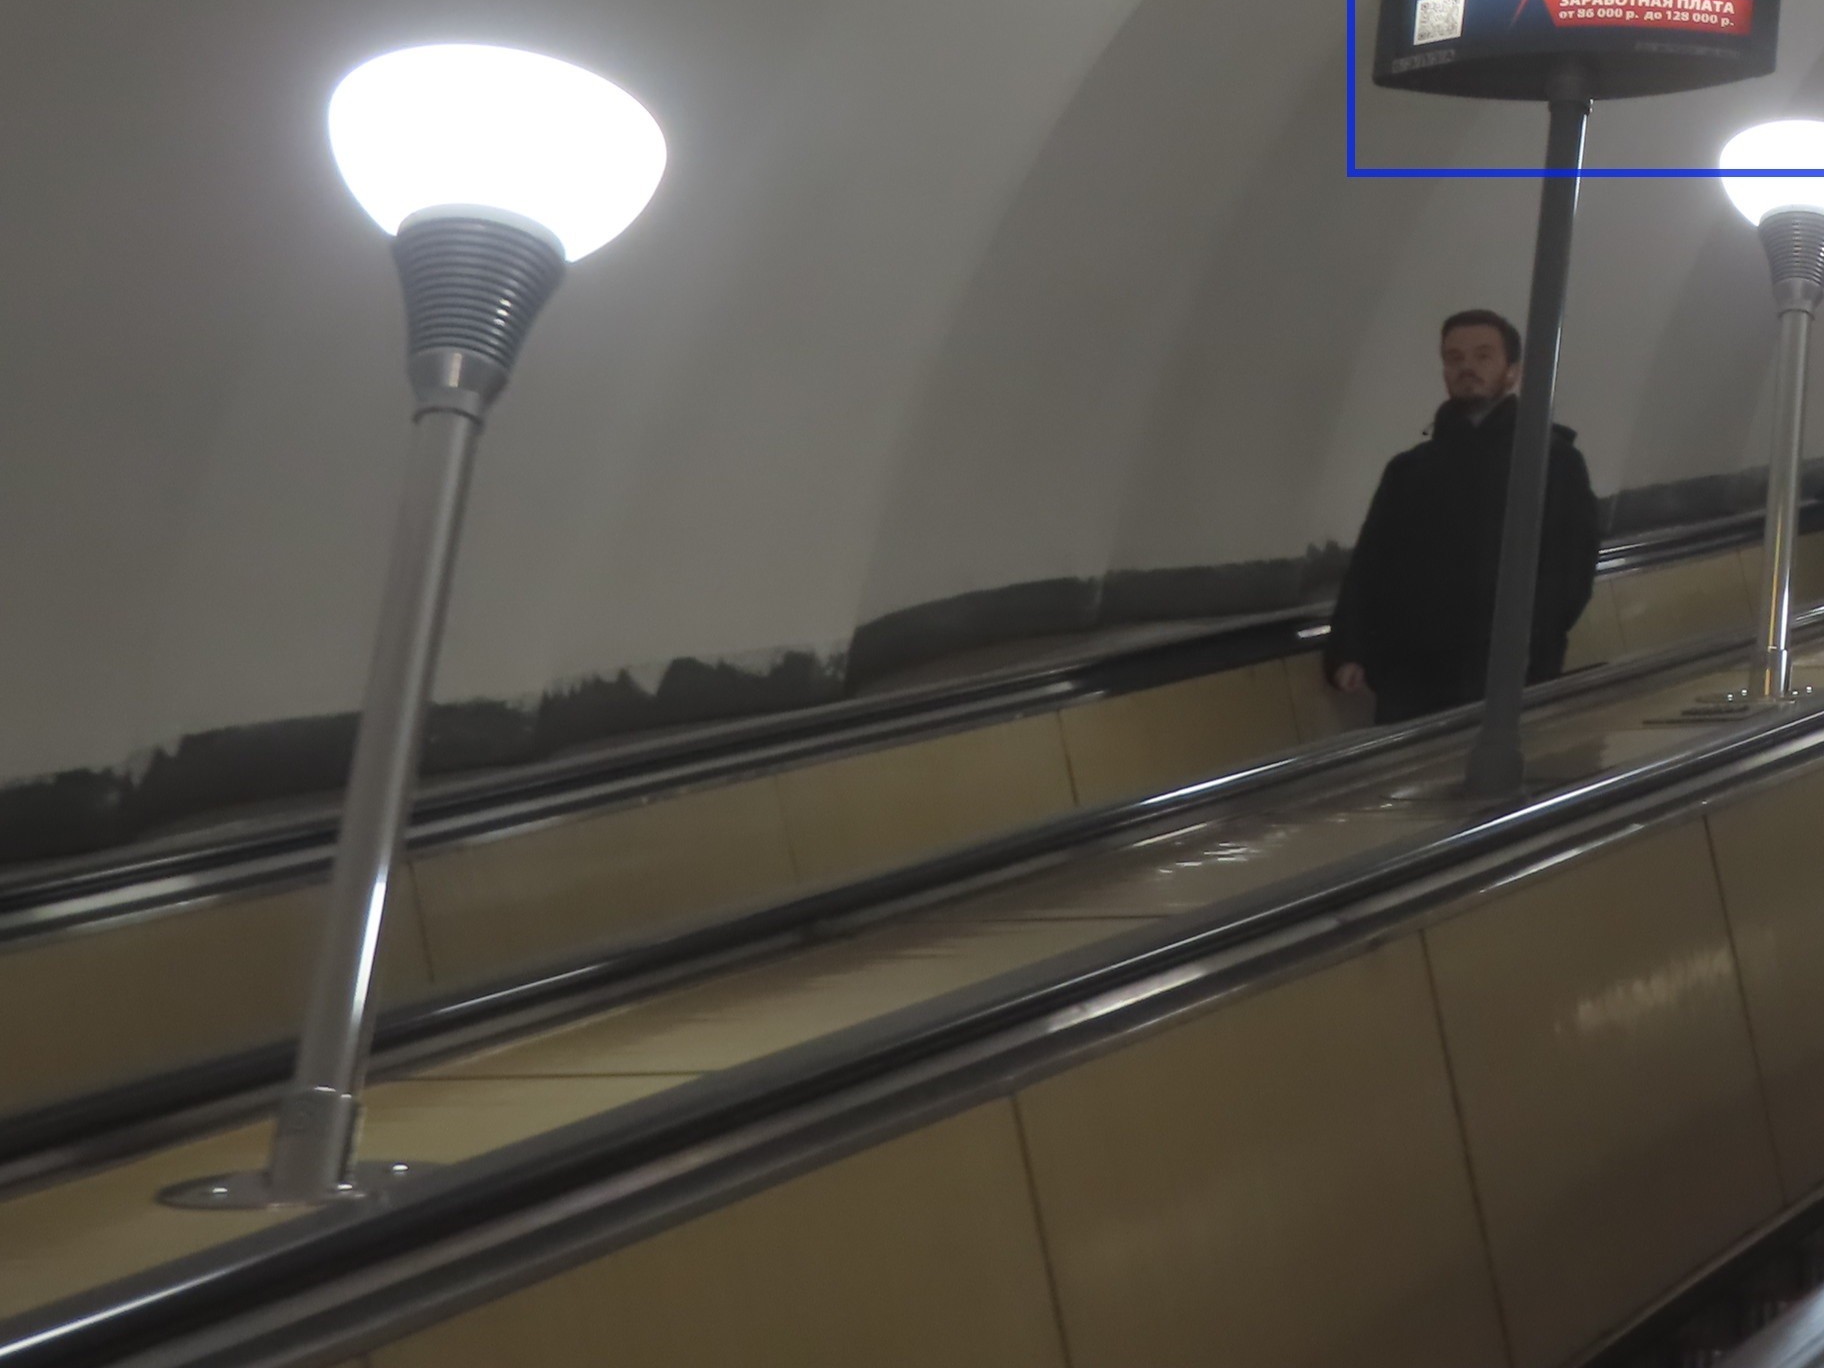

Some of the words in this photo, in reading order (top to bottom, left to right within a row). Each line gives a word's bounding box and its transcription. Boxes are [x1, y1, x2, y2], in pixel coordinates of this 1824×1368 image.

[1558, 10, 1575, 19] от
[1597, 8, 1623, 18] 000
[1625, 11, 1640, 21] р.
[1643, 11, 1663, 21] до
[1692, 13, 1718, 24] 000
[1721, 17, 1735, 28] р.
